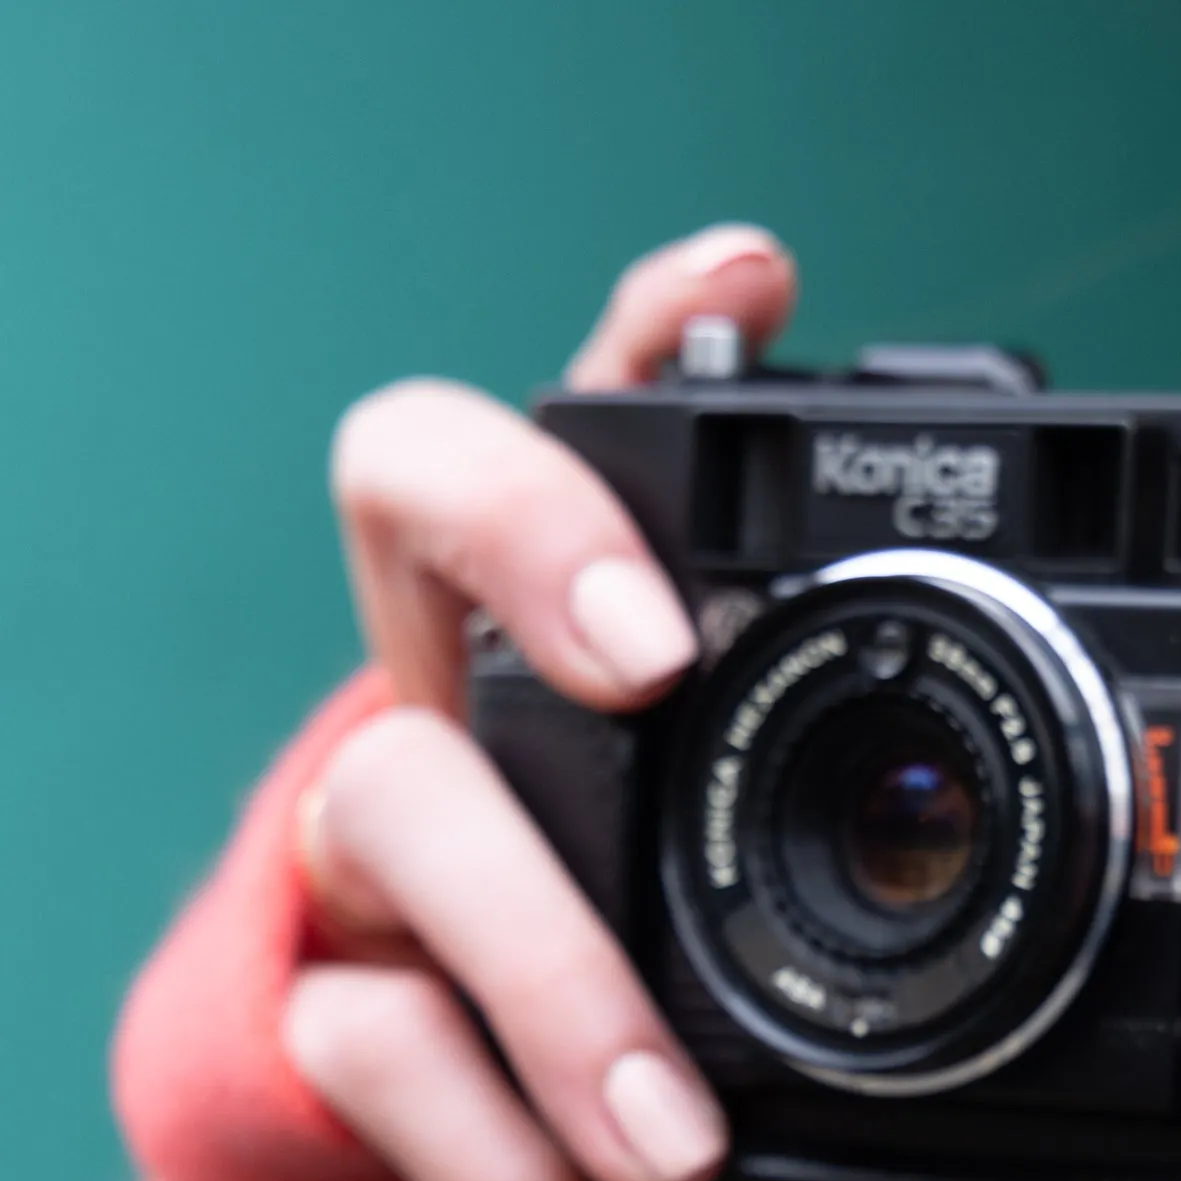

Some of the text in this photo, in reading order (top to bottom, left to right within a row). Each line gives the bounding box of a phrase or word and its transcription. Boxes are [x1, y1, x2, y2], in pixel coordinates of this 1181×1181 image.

[813, 435, 999, 495] Konica
[893, 495, 998, 541] C35
[705, 756, 742, 888] KONICA
[1012, 777, 1046, 891] JAPAN
